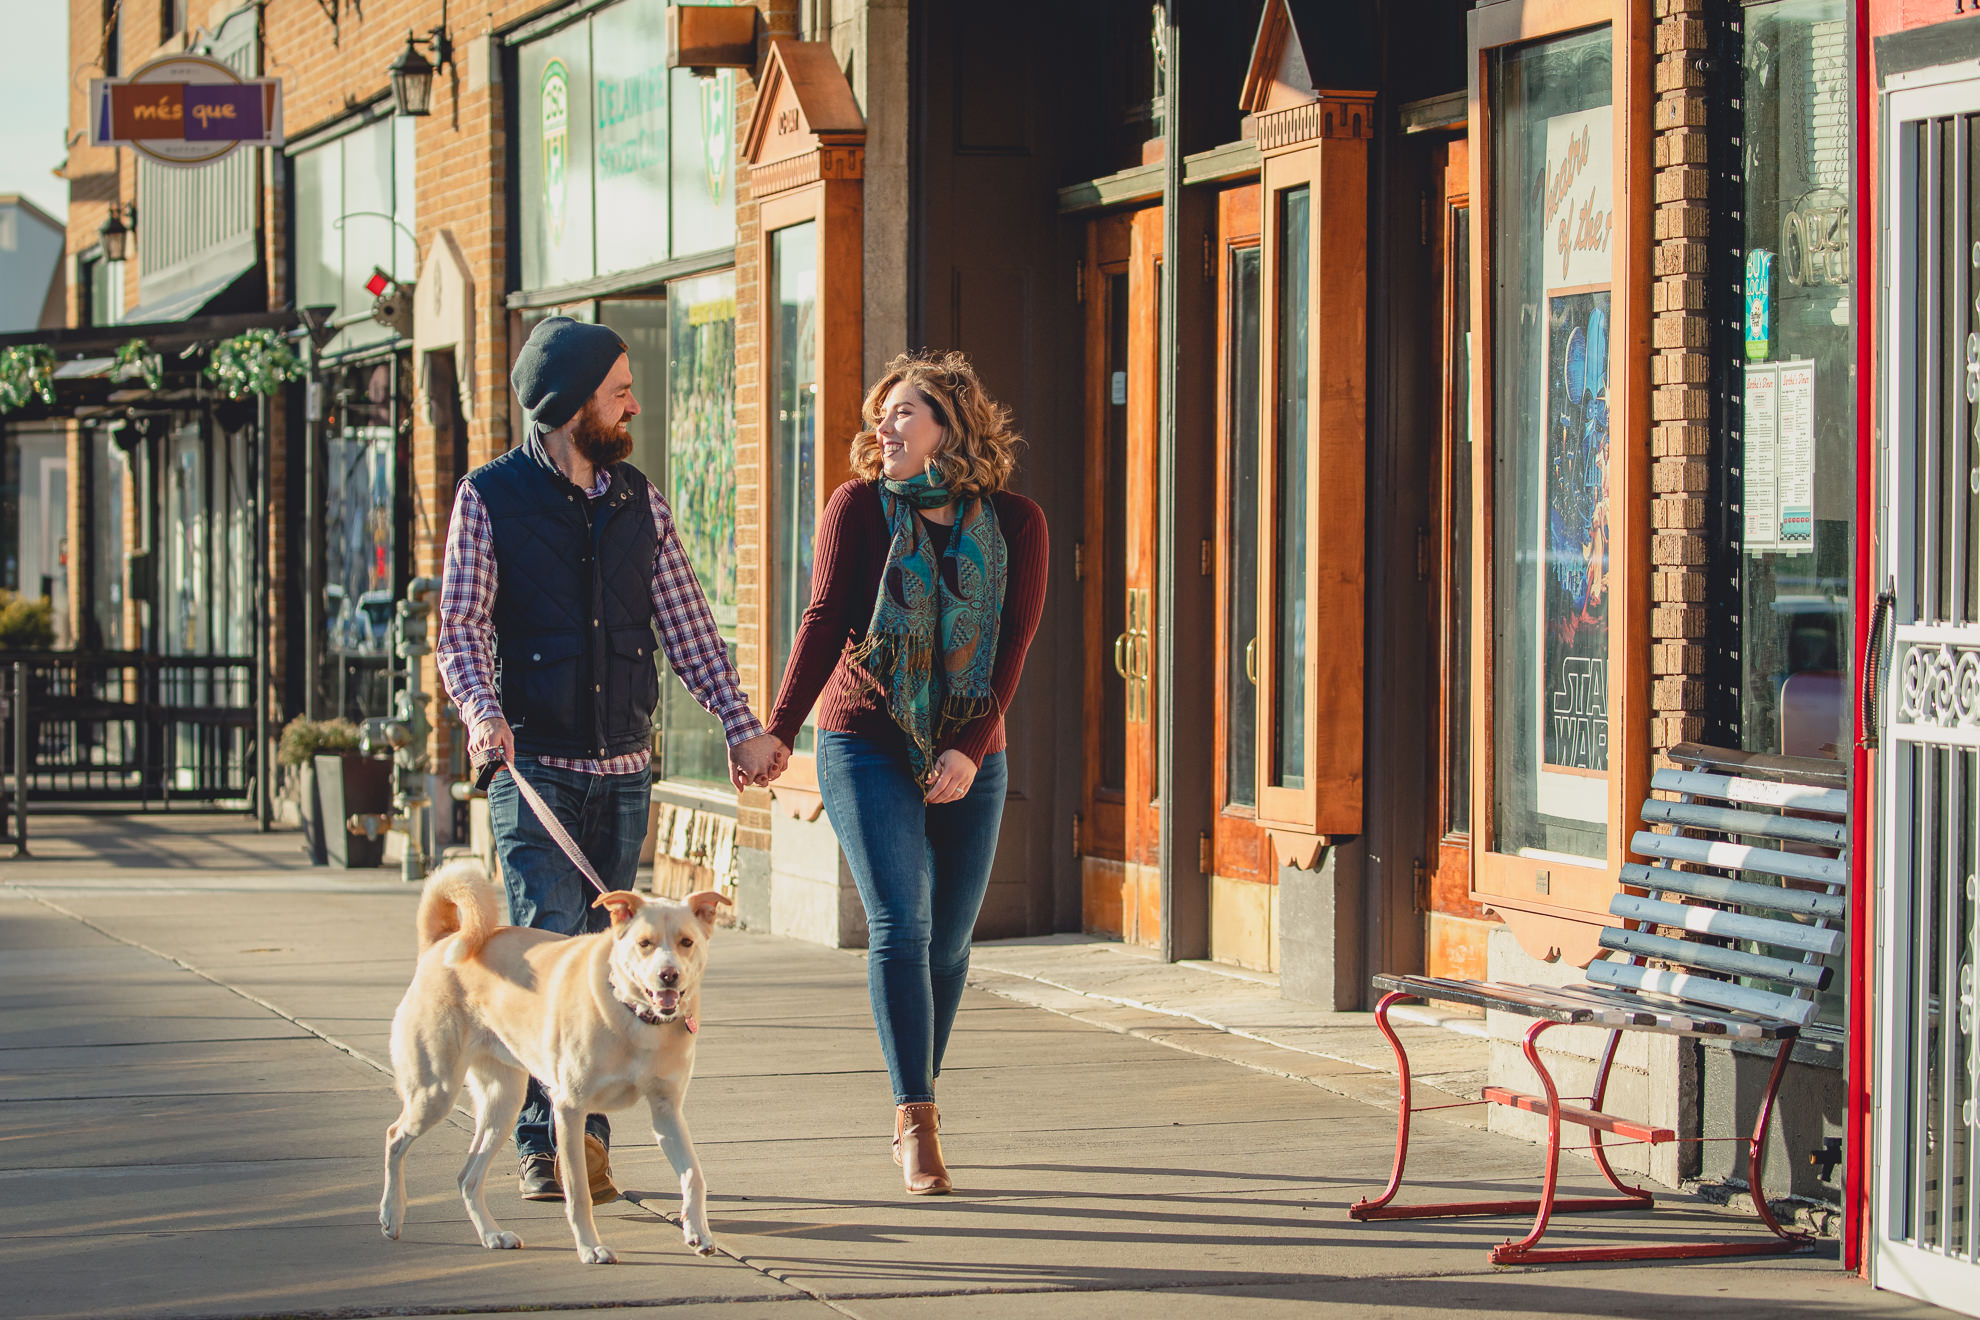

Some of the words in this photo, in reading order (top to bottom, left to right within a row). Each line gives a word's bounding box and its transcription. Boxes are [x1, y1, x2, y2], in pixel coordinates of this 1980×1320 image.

[133, 95, 183, 120] més
[192, 103, 237, 128] que
[598, 65, 665, 129] DELAWARE
[1558, 198, 1574, 280] of
[1574, 185, 1602, 251] the
[1746, 279, 1768, 296] LOCAL
[1747, 250, 1770, 278] BUY
[1554, 657, 1608, 716] STA
[1554, 716, 1608, 770] WAR
